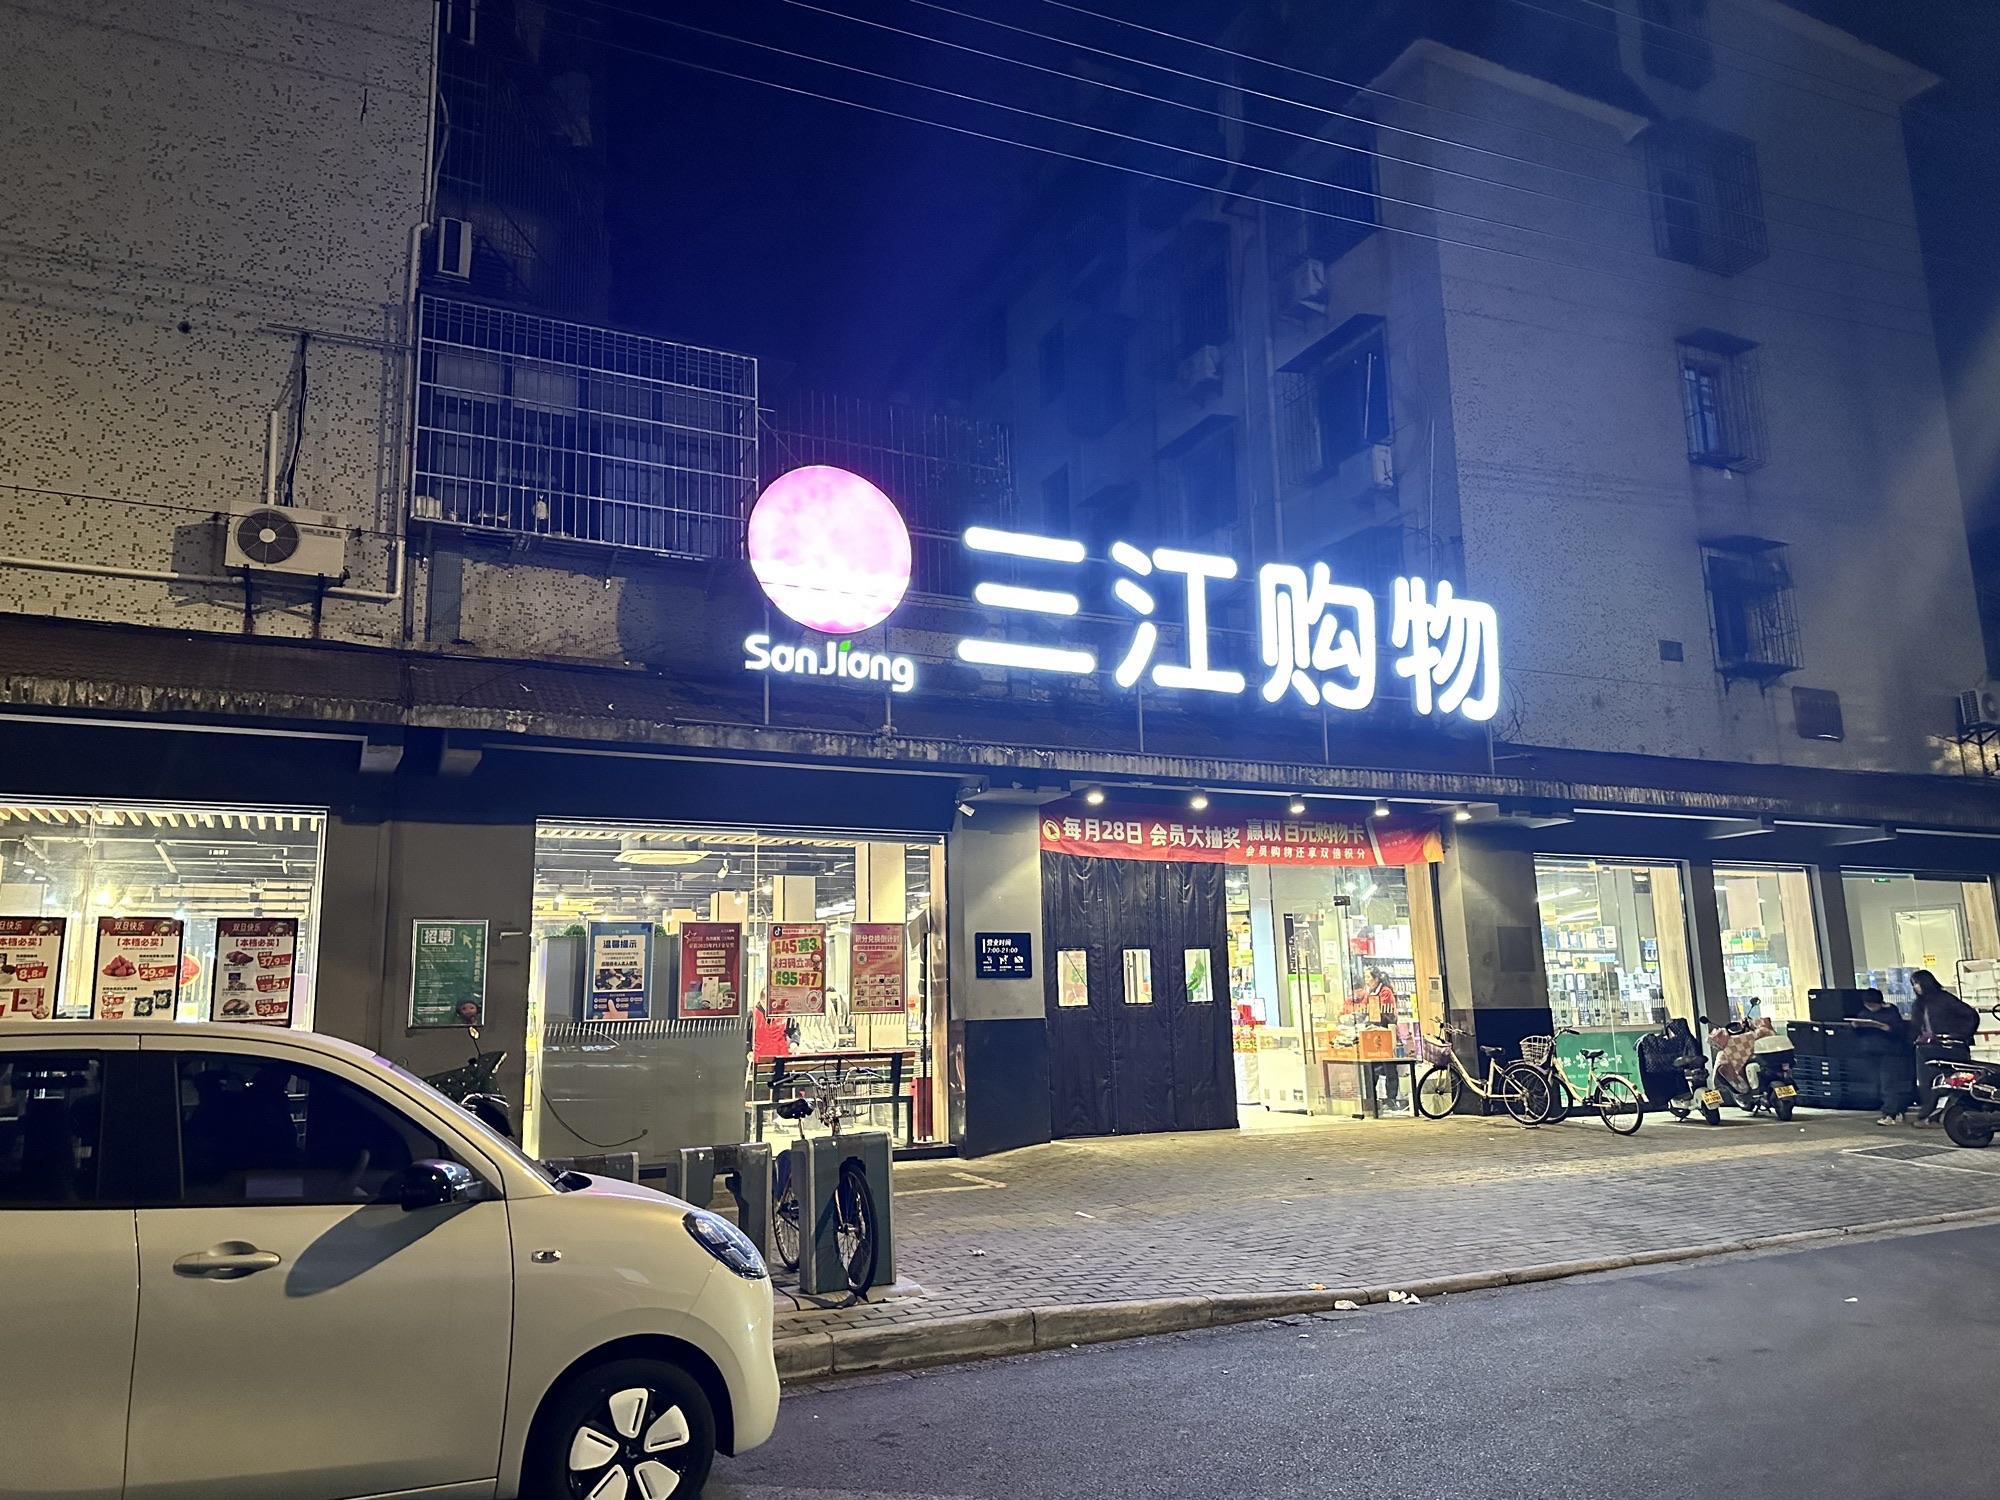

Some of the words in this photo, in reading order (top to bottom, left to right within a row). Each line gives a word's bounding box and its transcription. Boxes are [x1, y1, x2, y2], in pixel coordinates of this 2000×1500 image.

[956, 525, 1501, 722] 三江购物
[743, 632, 917, 694] SanJiang
[1062, 816, 1143, 845] 每月28日
[1149, 823, 1241, 850] 会员大抽奖
[1245, 845, 1366, 860] 会员购物还享双倍积分
[114, 921, 145, 931] 双旦快乐
[232, 922, 262, 932] 双旦快乐
[424, 929, 452, 944] 招聘
[855, 934, 900, 944] 积分兑换倒计时
[986, 938, 1012, 947] 营业时间
[602, 939, 638, 949] 温馨提示
